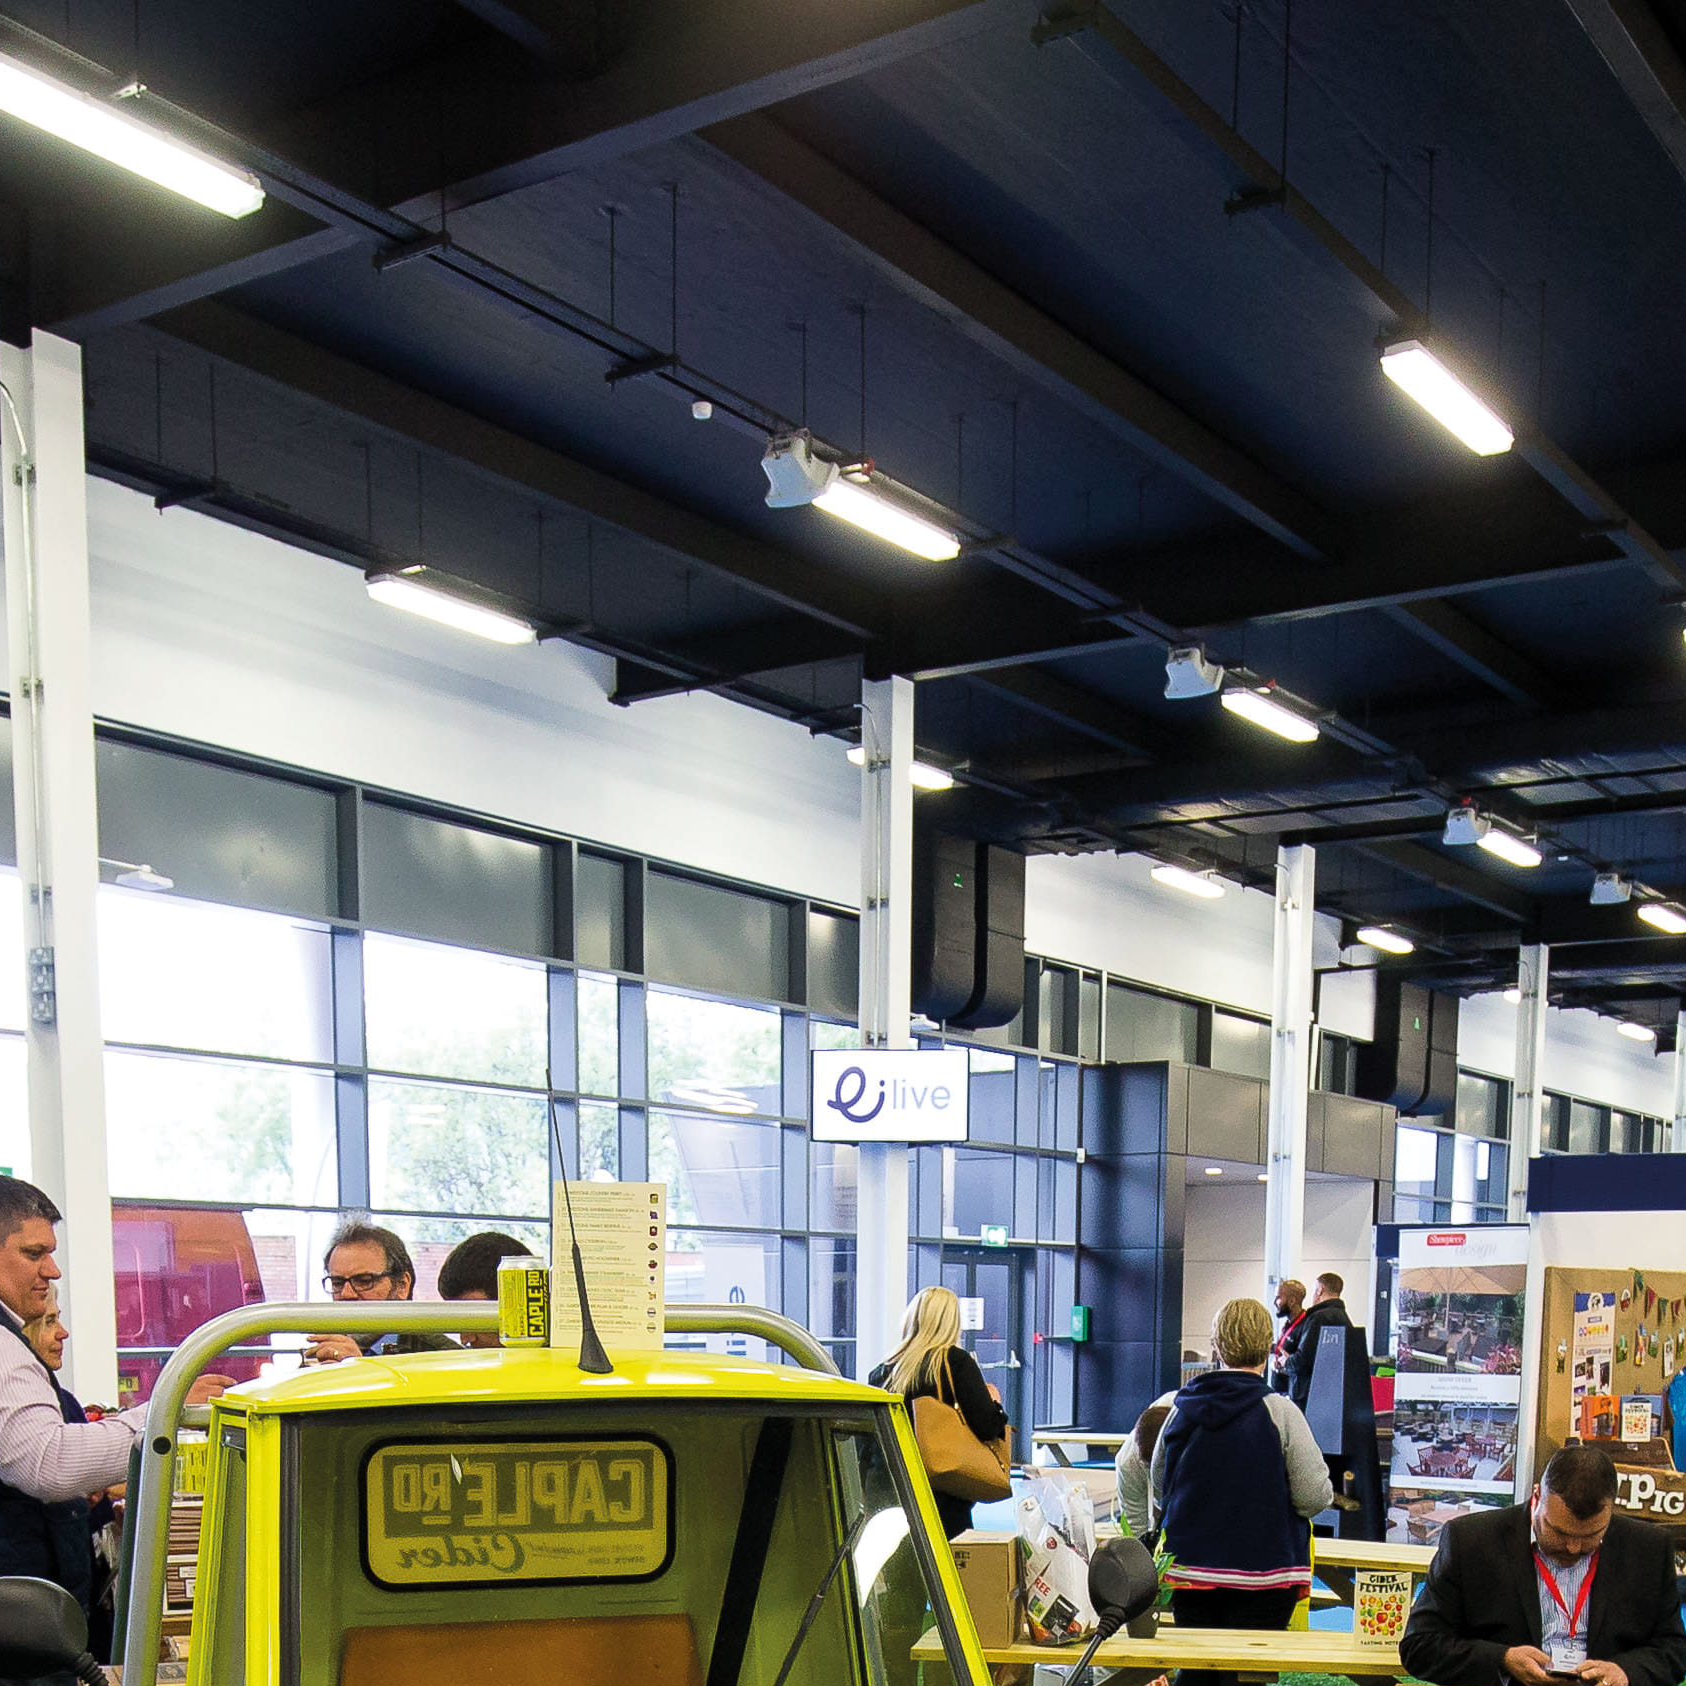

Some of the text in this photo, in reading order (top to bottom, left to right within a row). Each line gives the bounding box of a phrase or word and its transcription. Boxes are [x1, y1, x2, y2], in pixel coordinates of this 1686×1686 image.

[892, 1078, 951, 1110] live
[528, 1287, 544, 1337] CAPLE
[1359, 1582, 1408, 1594] FESTIVAL
[1369, 1574, 1398, 1584] CIDER
